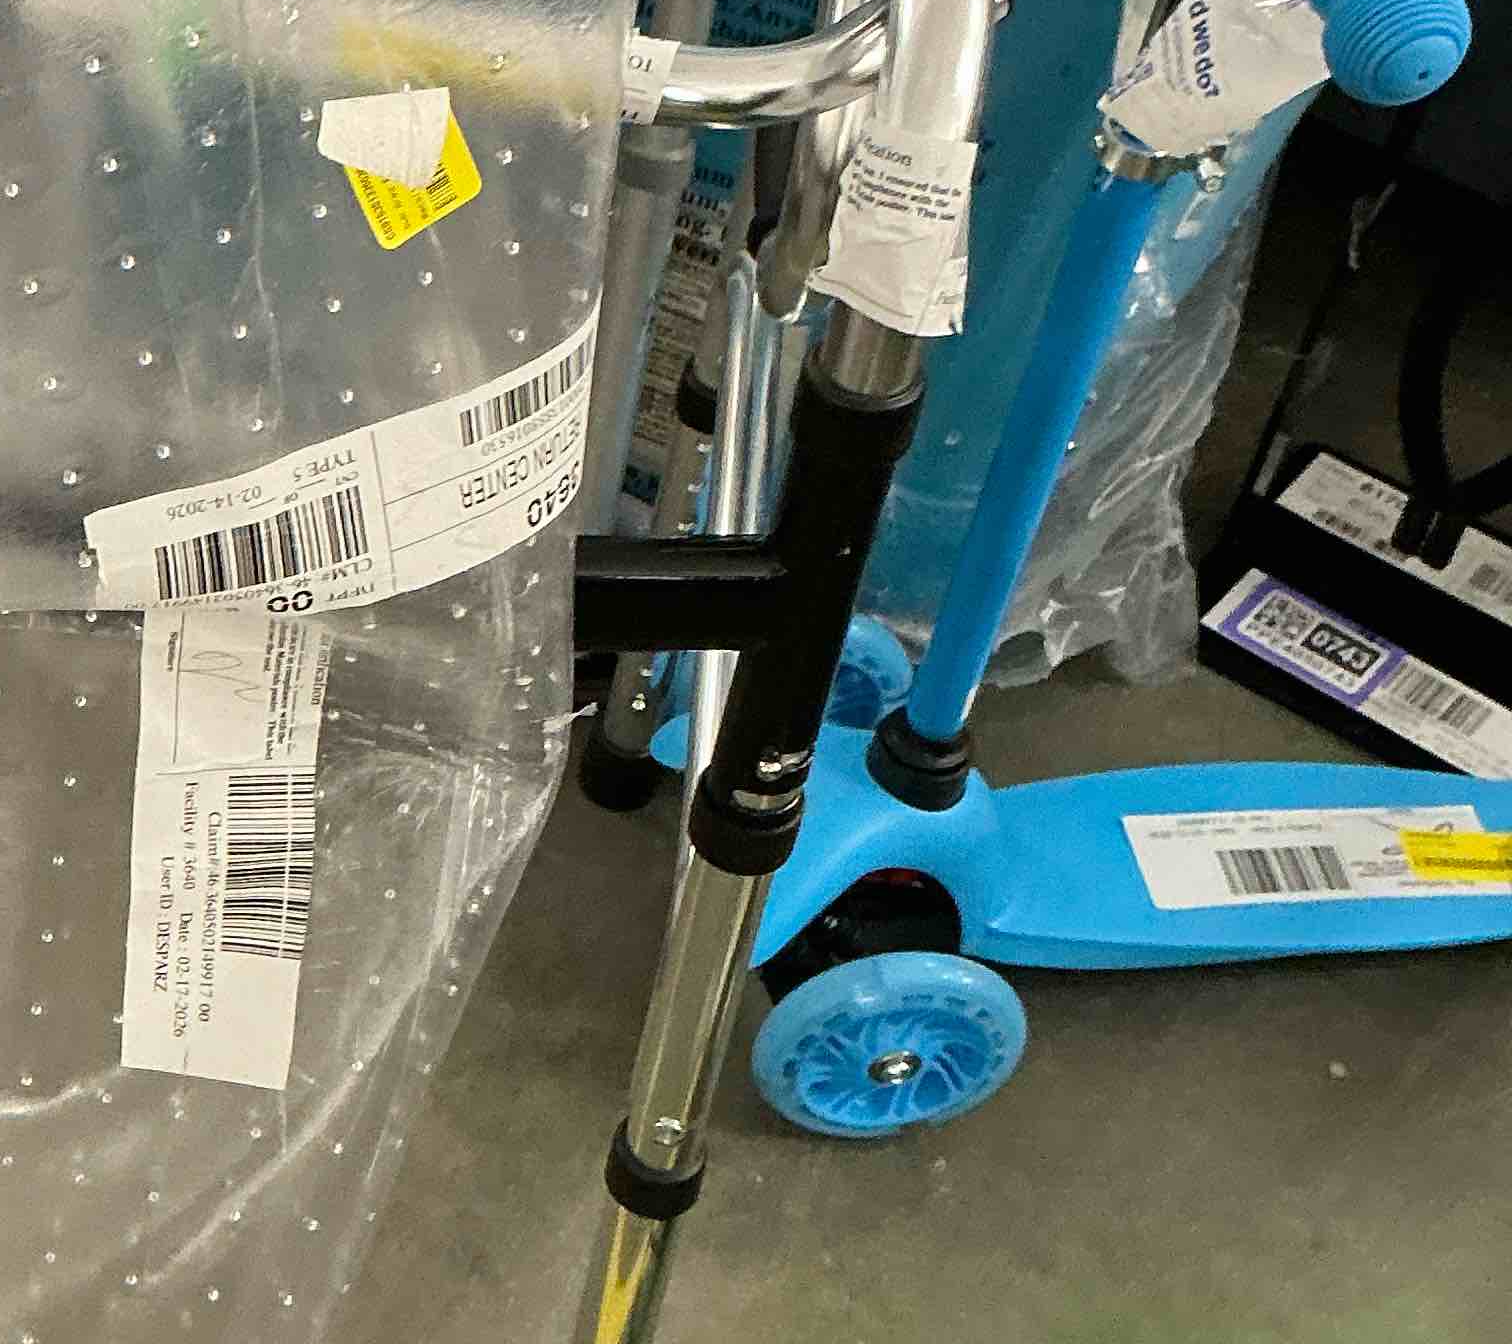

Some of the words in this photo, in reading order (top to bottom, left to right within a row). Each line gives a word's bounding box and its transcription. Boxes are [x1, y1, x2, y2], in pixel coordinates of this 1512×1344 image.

[305, 449, 357, 480] TYPE
[459, 455, 530, 510] CENTER
[166, 485, 262, 521] 02-14-2026
[181, 782, 200, 835] Facility
[159, 856, 176, 890] User
[182, 856, 197, 891] 3640
[158, 894, 175, 910] ID
[152, 921, 172, 993] DESPARZ
